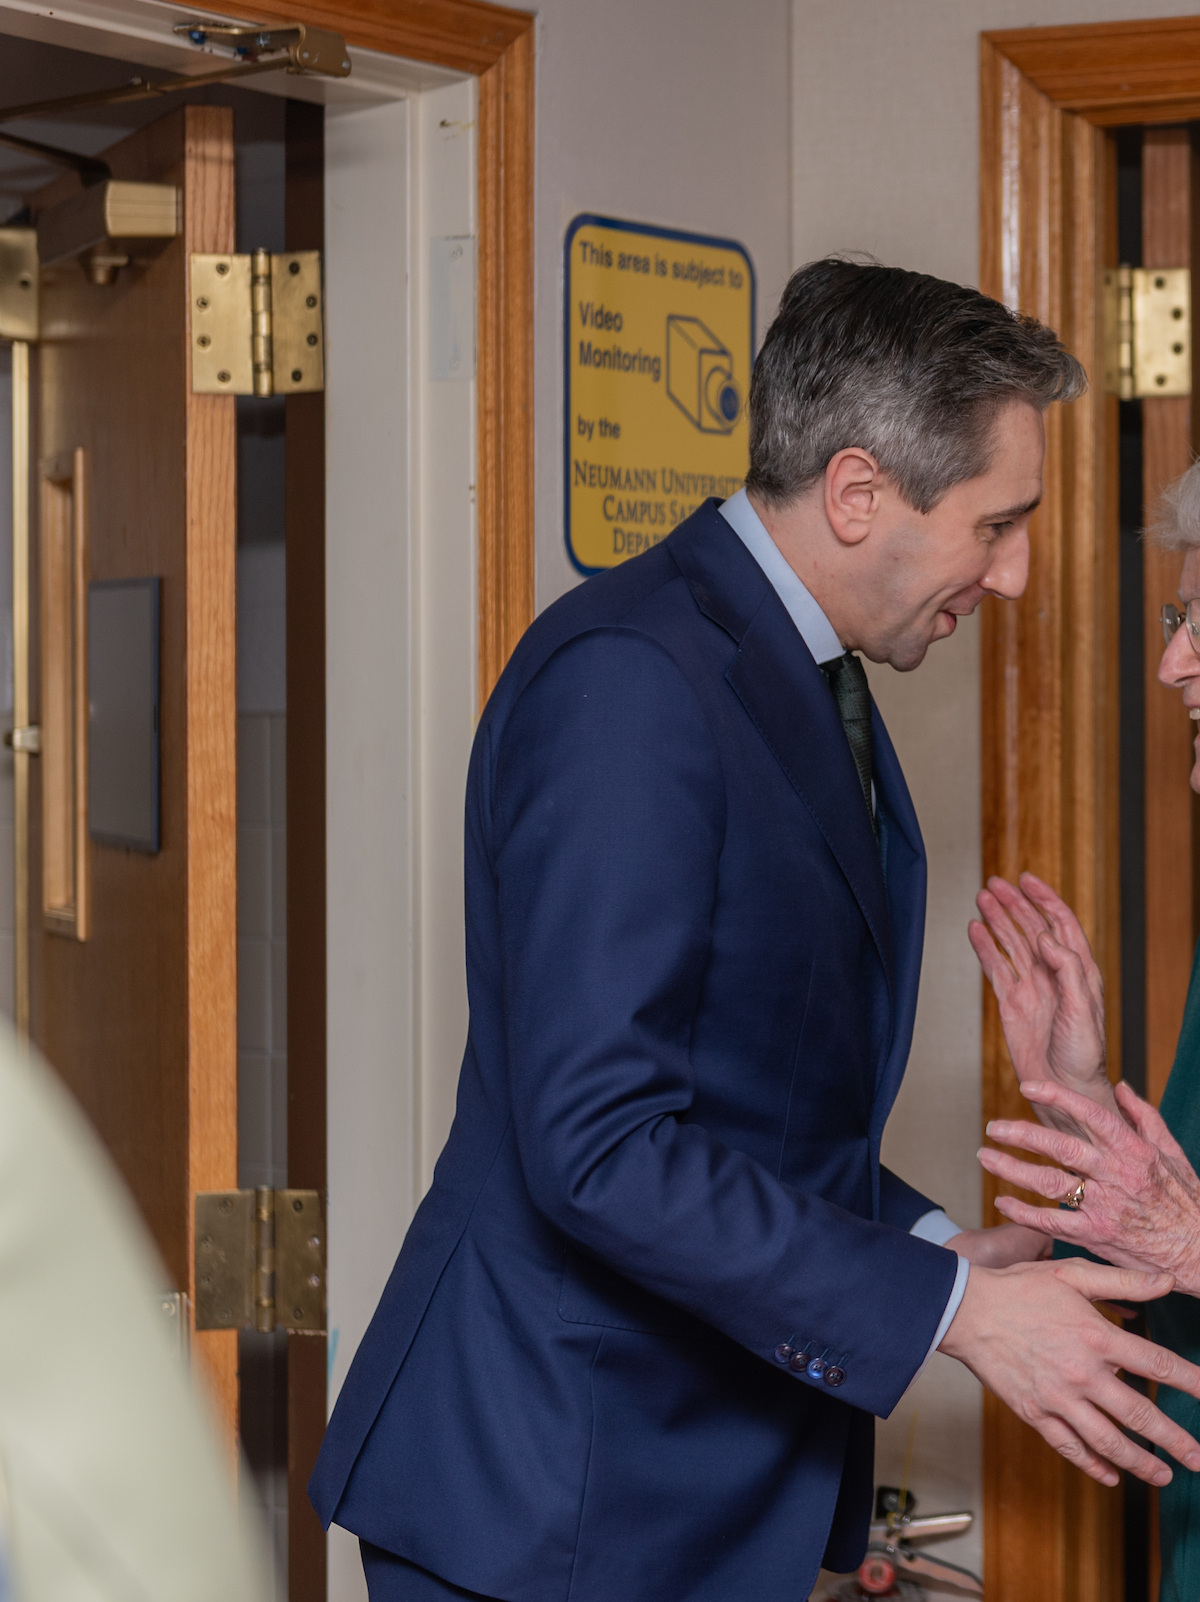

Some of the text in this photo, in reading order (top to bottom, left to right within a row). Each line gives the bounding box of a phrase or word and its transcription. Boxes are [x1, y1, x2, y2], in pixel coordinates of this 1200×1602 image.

[579, 241, 743, 289] This area is subject to
[579, 302, 623, 333] Video
[579, 341, 661, 382] Monitoring
[578, 415, 621, 441] by the
[574, 460, 656, 493] NEUMANN
[603, 495, 665, 526] CAMPUS
